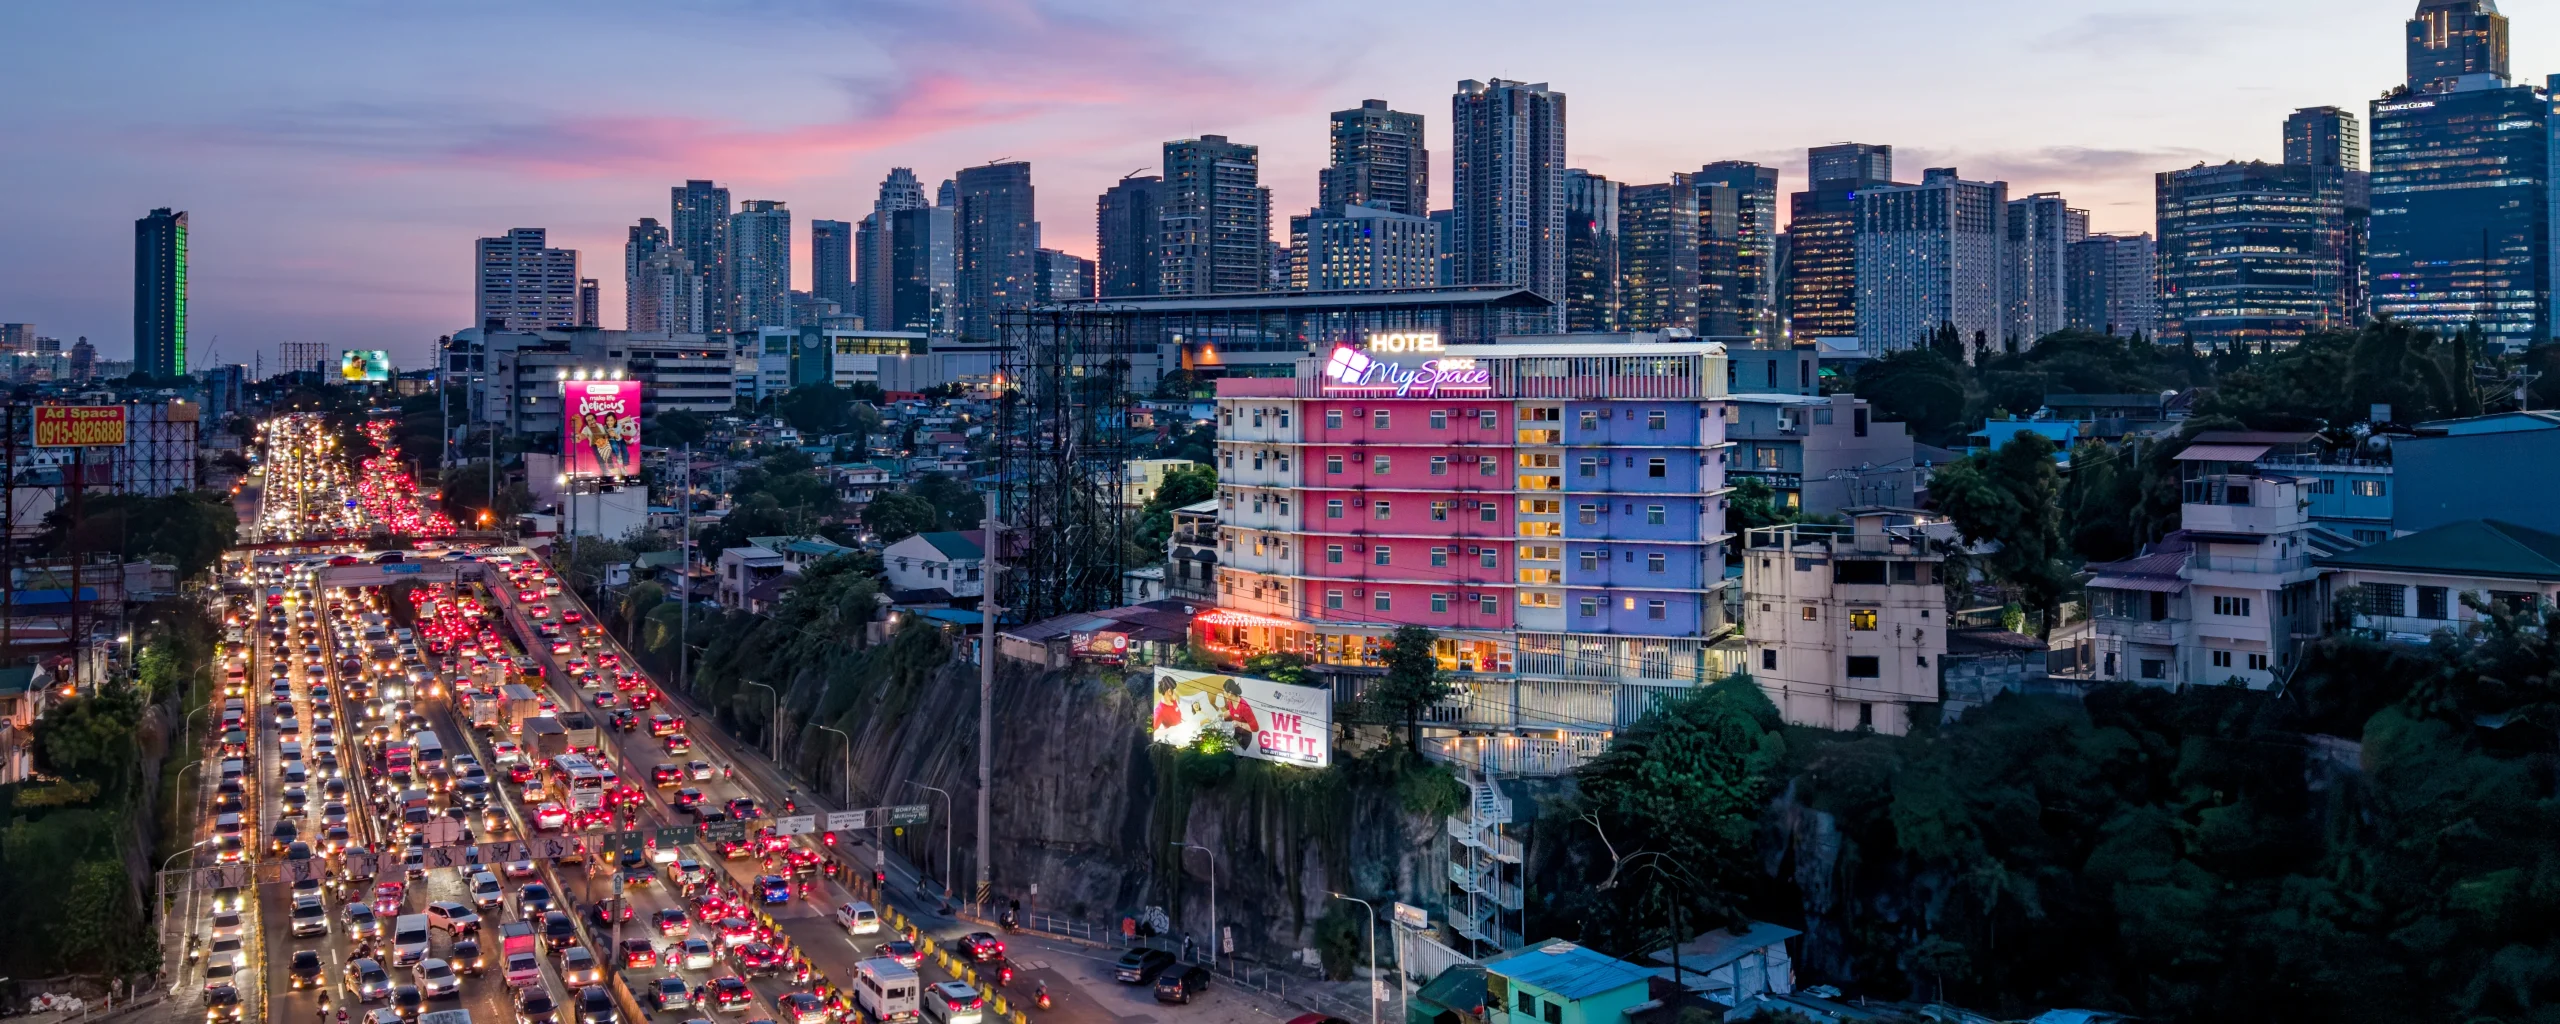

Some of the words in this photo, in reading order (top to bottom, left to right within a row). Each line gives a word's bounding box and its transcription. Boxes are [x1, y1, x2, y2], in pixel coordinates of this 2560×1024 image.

[2377, 104, 2408, 112] ALLIANCE
[2409, 101, 2435, 109] GLOBAL
[1371, 333, 1446, 352] HOTEL
[1360, 360, 1489, 396] MySpace
[44, 408, 65, 419] Ad
[70, 407, 118, 420] Space
[579, 396, 626, 416] delicious
[39, 420, 123, 443] 0915-9826888
[1270, 711, 1302, 734] WE
[1258, 730, 1294, 752] GET
[1299, 736, 1323, 758] IT.
[611, 833, 636, 841] SEX
